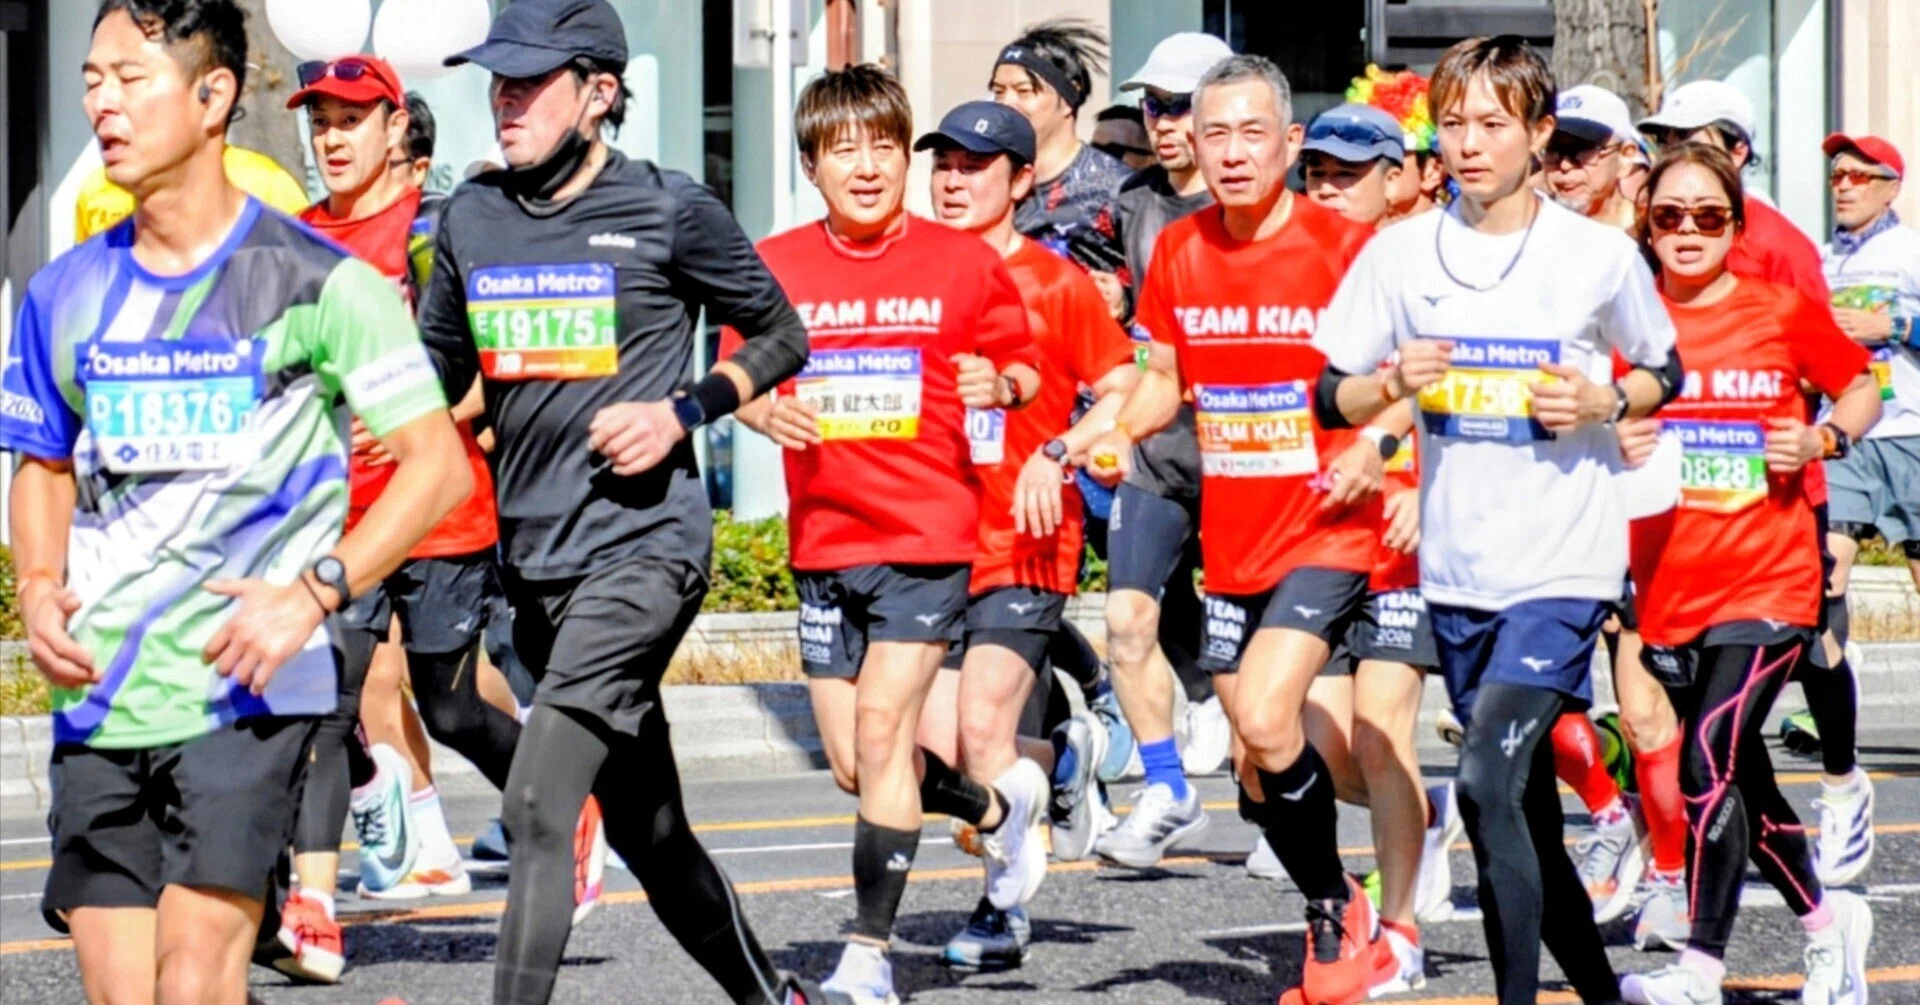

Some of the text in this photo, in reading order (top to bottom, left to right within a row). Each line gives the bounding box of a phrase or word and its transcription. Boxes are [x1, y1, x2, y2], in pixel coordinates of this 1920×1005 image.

[477, 272, 602, 295] Osaka Metro
[796, 297, 942, 326] EAM KIAI
[492, 308, 597, 348] 19175
[92, 350, 239, 376] Osaka Metro
[857, 353, 912, 371] Metro
[1487, 344, 1549, 363] Metro
[1201, 390, 1247, 409] Osaka
[115, 388, 234, 435] 18376
[1201, 418, 1298, 443] TEAM KIAI
[1699, 427, 1759, 444] Metro
[1378, 591, 1426, 613] TEAM
[1379, 610, 1418, 629] KIAI
